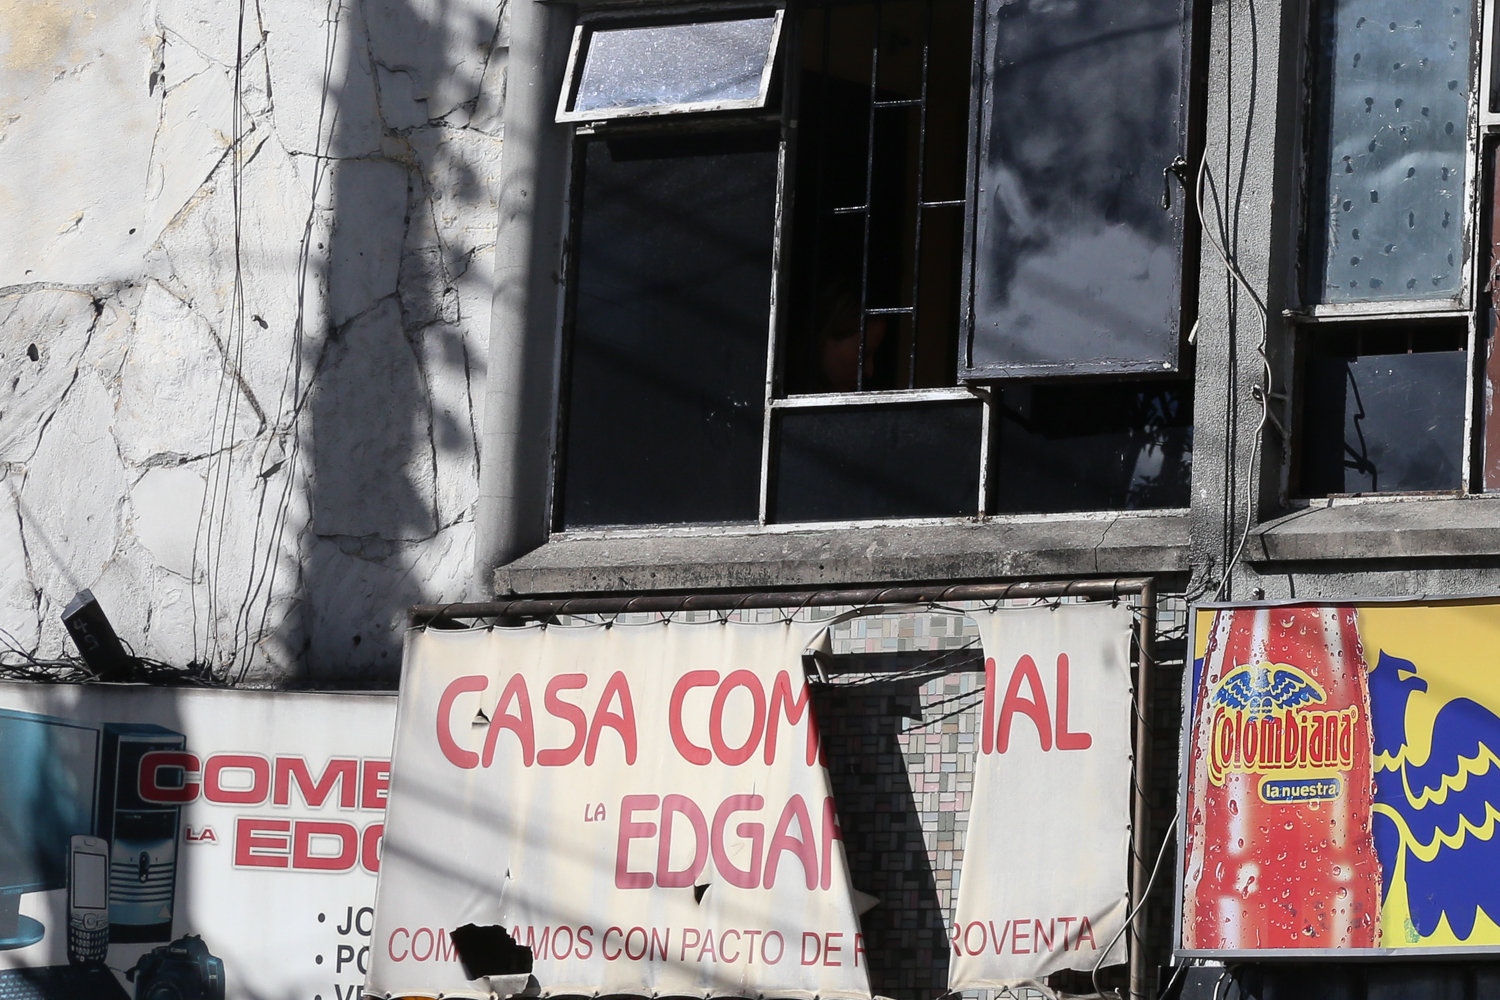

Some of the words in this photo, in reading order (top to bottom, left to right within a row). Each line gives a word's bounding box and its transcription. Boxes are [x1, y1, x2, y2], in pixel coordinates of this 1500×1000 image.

[437, 671, 637, 769] CASA
[1265, 784, 1280, 797] la
[1282, 782, 1337, 797] nuestra
[585, 804, 605, 821] LA
[188, 829, 215, 840] LA
[603, 927, 669, 960] CON
[682, 929, 783, 964] PACTO
[802, 932, 843, 966] DE
